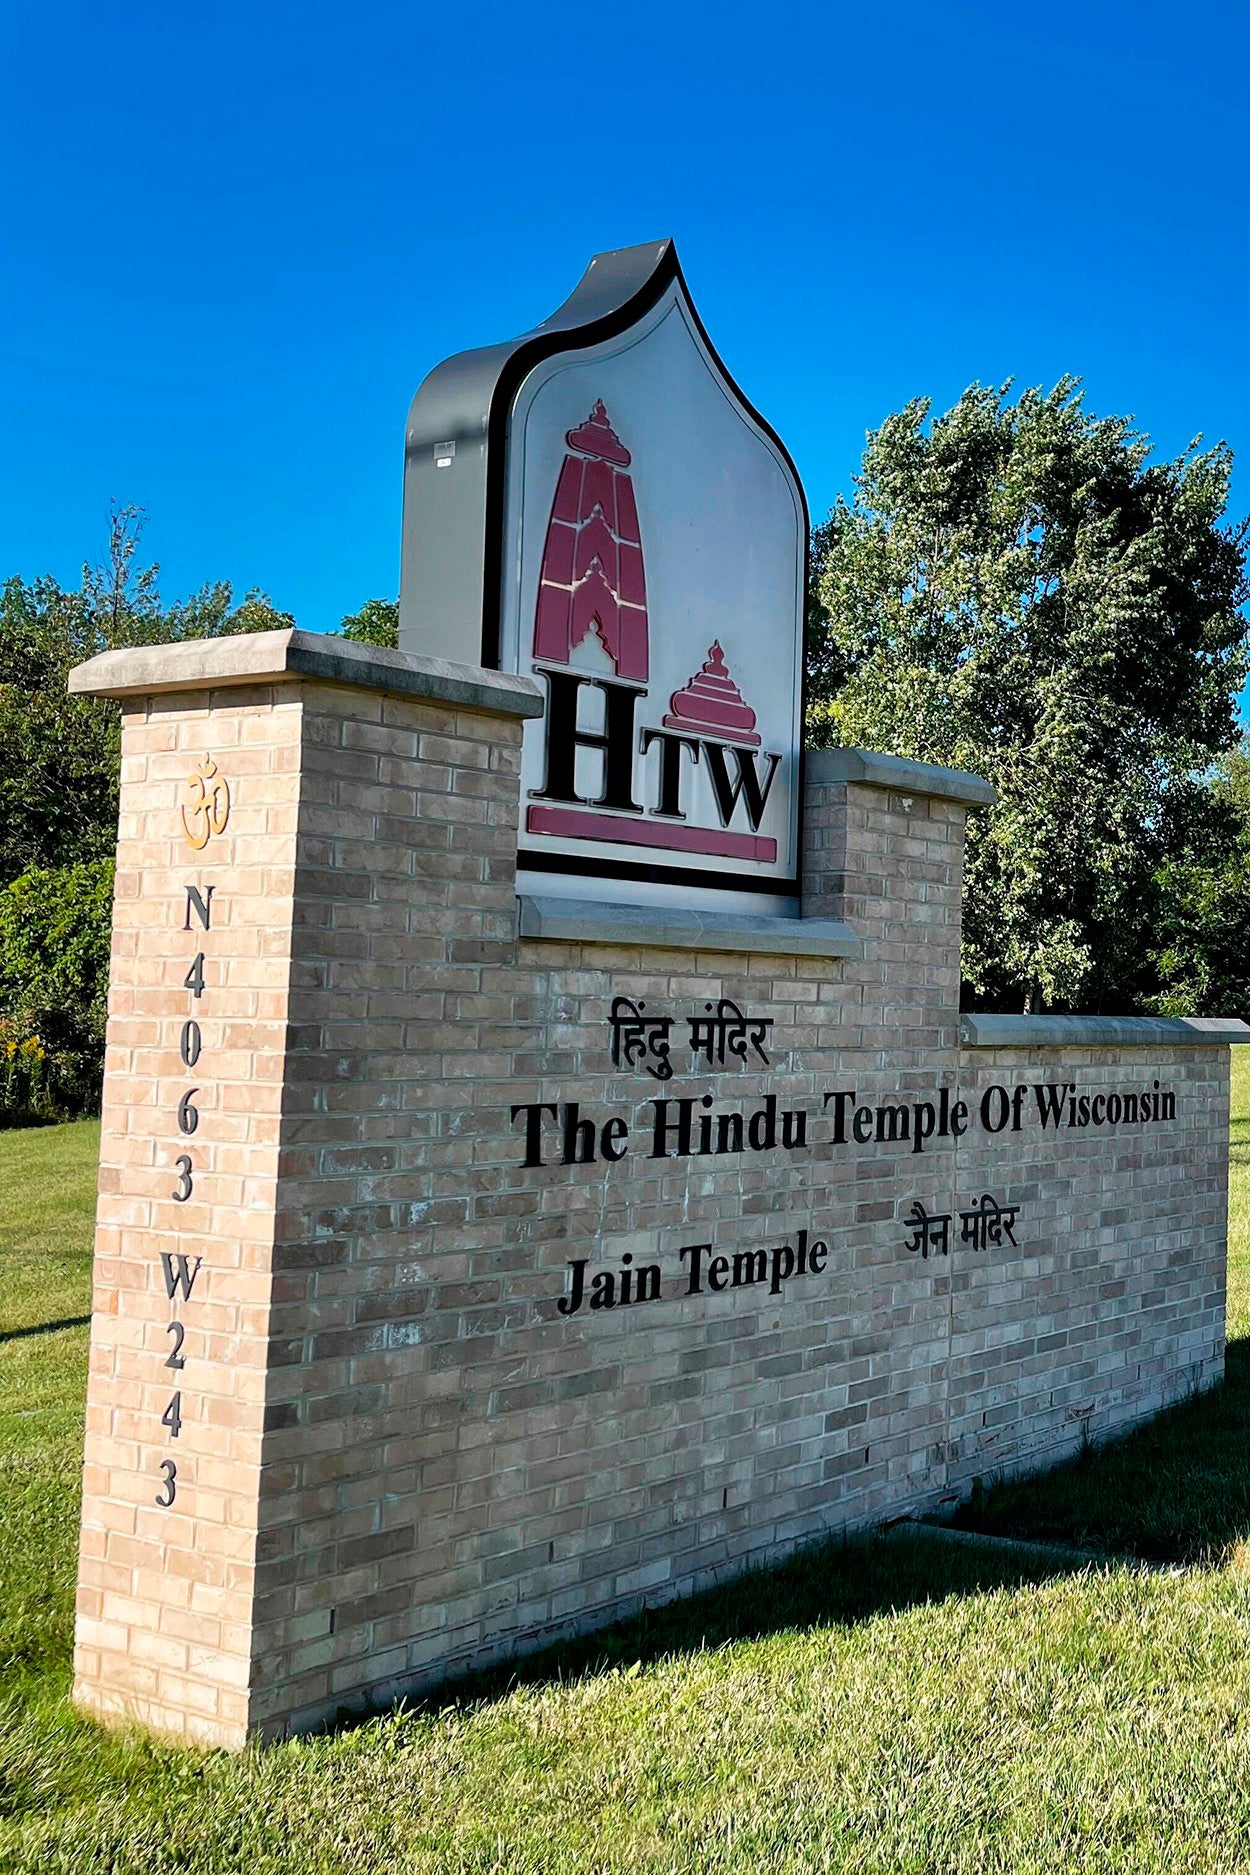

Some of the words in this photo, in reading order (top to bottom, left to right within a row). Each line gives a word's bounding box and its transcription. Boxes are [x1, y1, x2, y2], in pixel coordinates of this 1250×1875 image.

[528, 665, 783, 832] HTW
[686, 998, 774, 1065] मंदिर
[511, 1102, 629, 1168] The
[646, 1094, 808, 1160] Hindu
[824, 1087, 969, 1153] Temple
[980, 1083, 1028, 1134] Of
[1033, 1080, 1177, 1130] Wisconsin
[904, 1201, 952, 1259] जैन
[959, 1194, 1021, 1252] मंदिर
[557, 1253, 662, 1315] Jain
[679, 1230, 828, 1295] Temple
